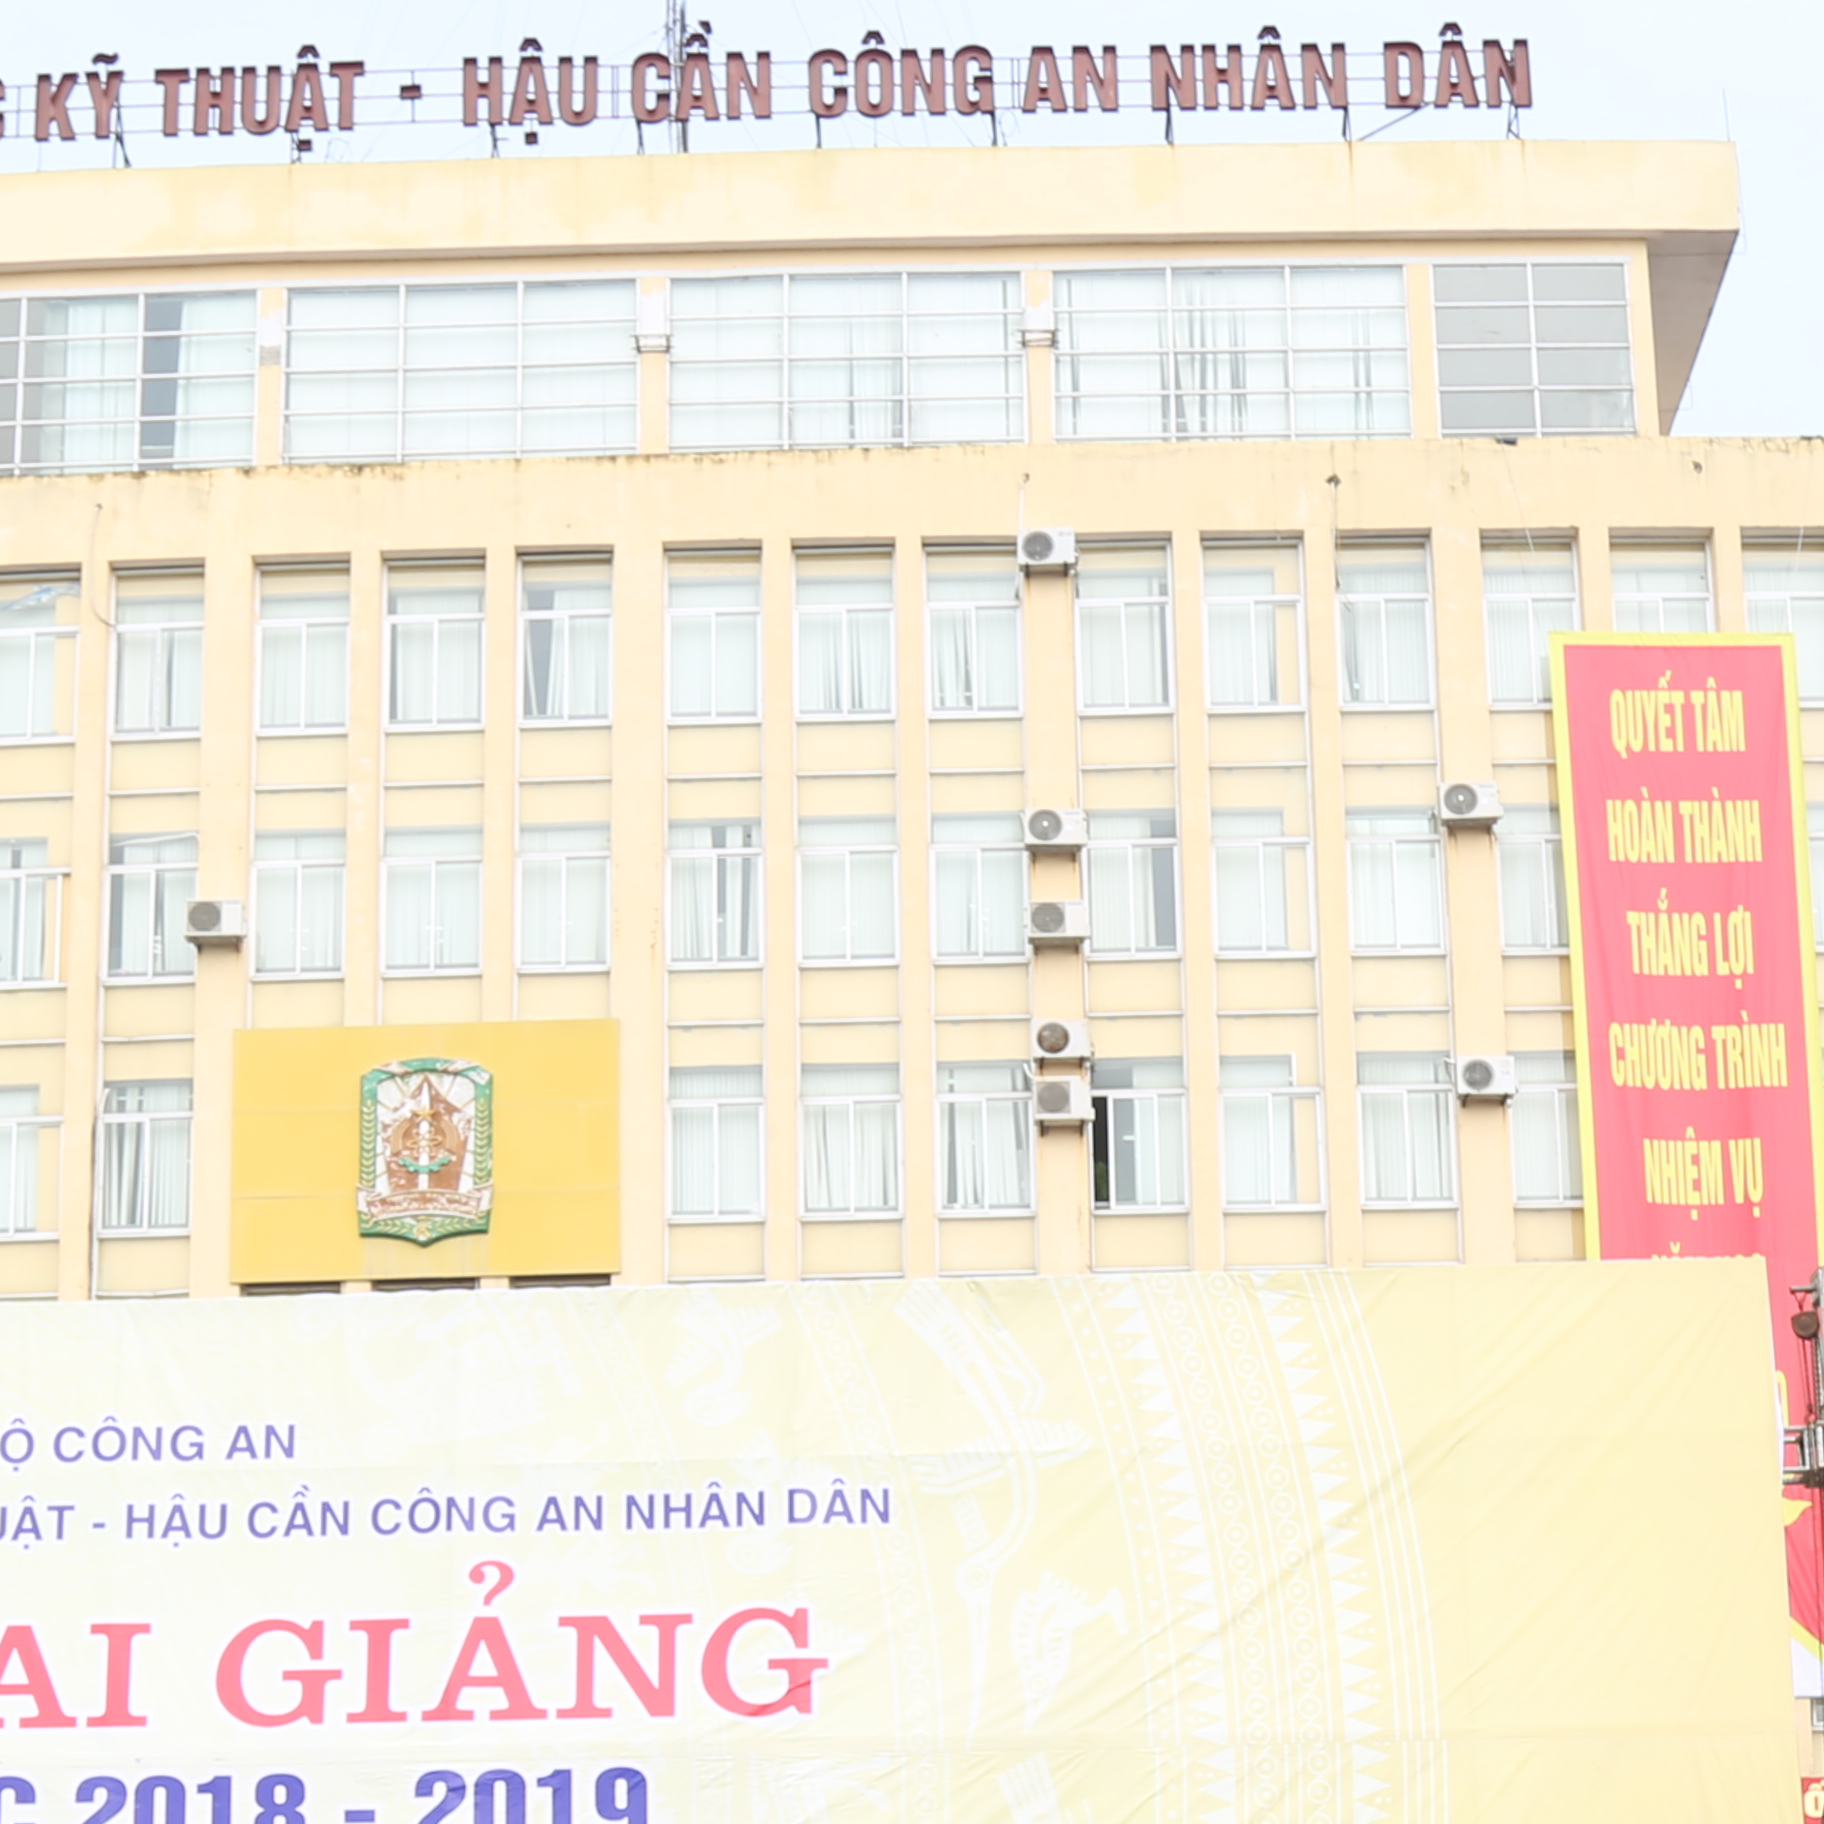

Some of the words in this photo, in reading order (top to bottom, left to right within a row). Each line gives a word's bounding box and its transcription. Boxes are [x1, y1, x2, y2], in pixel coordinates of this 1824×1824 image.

[35, 53, 124, 141] KỸ
[155, 44, 365, 153] THUẬT
[398, 83, 422, 101] -
[462, 37, 600, 145] HẬU
[630, 20, 772, 124] CẦN
[808, 30, 995, 119] CÔNG
[1022, 45, 1119, 114] AN
[1149, 26, 1348, 113] NHÂN
[1382, 22, 1532, 109] DÂN
[1609, 670, 1685, 759] QUYẾT
[1690, 677, 1746, 752] TÂM
[1606, 786, 1675, 863] HOÀN
[1679, 786, 1762, 863] THÀNH
[1626, 888, 1709, 976] THẮNG
[1713, 905, 1755, 990] LỢI
[1608, 1018, 1708, 1090] CHƯƠNG
[1711, 1010, 1788, 1089] TRÌNH
[1643, 1126, 1724, 1221] NHIỆM
[1728, 1137, 1764, 1217] VỤ
[52, 1416, 206, 1462] CÔNG
[225, 1424, 297, 1461] AN
[125, 1494, 229, 1547] HẬU
[246, 1484, 351, 1539] CẦN
[370, 1488, 517, 1535] CÔNG
[536, 1494, 604, 1532] AN
[624, 1481, 767, 1531] NHÂN
[786, 1479, 892, 1526] DÂN
[215, 1560, 829, 1728] GIẢNG
[344, 1809, 376, 1824] -
